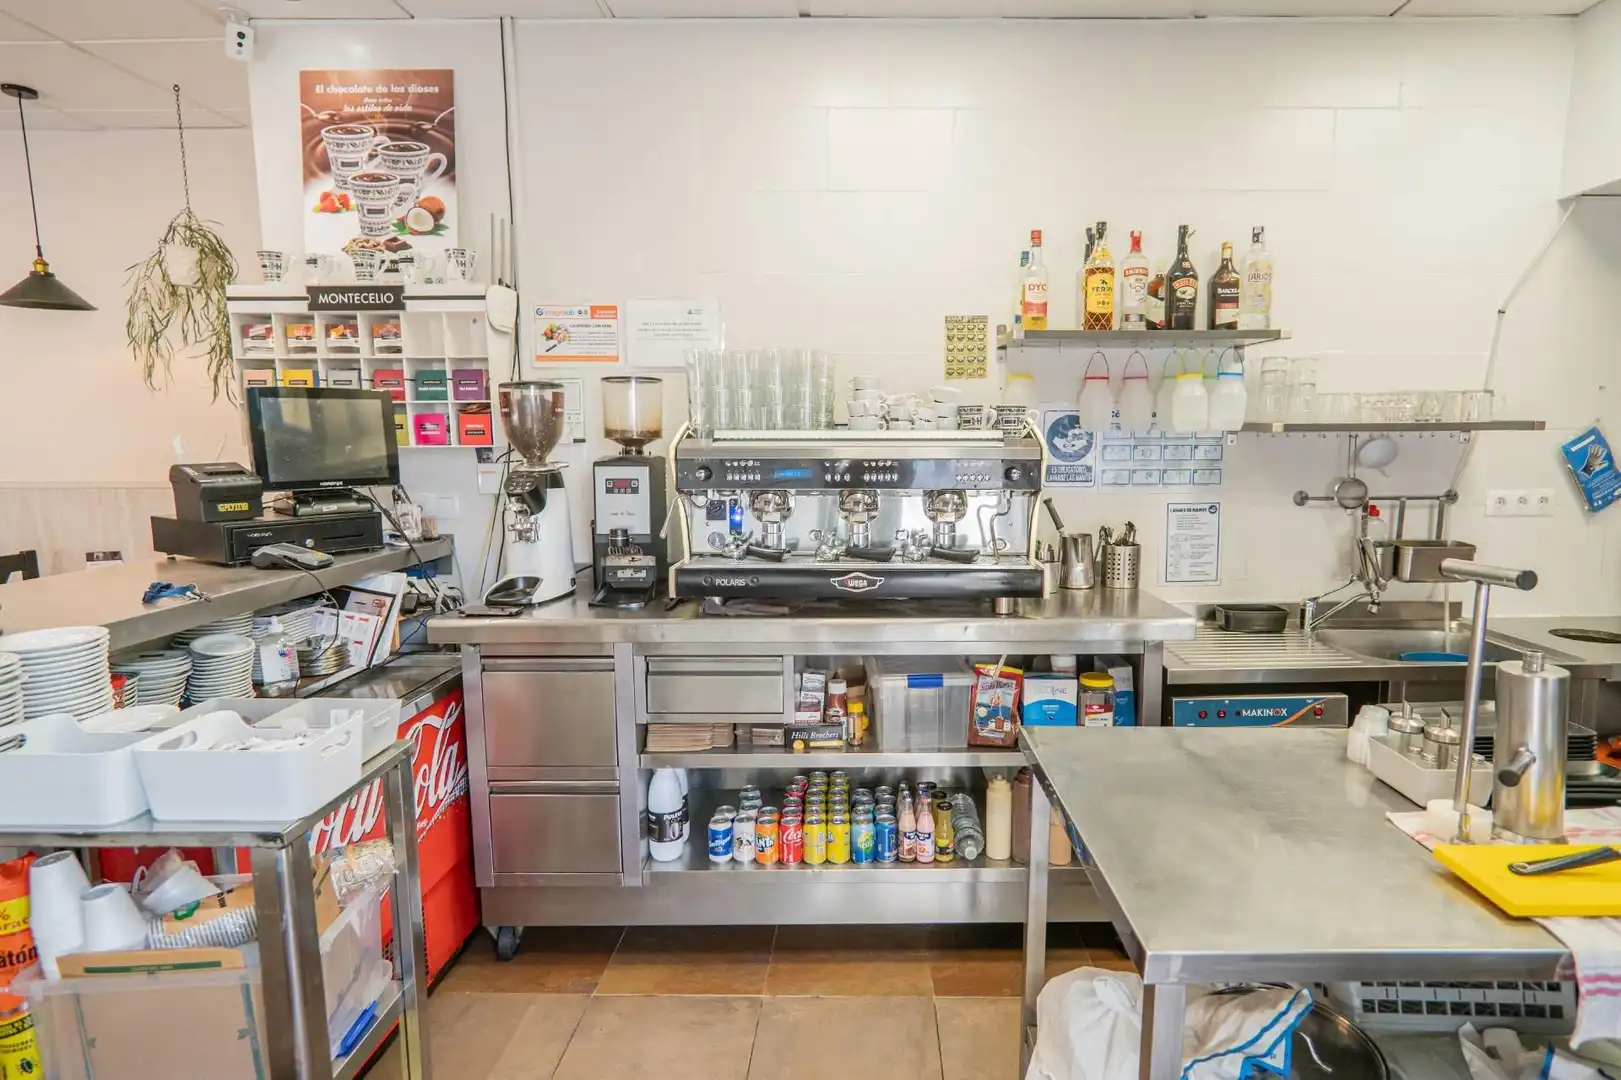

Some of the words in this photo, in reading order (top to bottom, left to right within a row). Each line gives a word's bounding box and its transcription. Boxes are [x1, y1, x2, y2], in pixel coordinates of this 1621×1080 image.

[315, 84, 324, 94] El
[326, 84, 374, 94] chocolate
[375, 84, 389, 94] de
[391, 84, 405, 94] los
[408, 84, 440, 94] dioses
[318, 292, 394, 304] MONTECELIO
[715, 578, 746, 586] POLARIS
[1242, 708, 1288, 717] MAKINOX
[791, 731, 808, 739] Hills
[810, 730, 839, 740] Brothers
[0, 943, 38, 969] atón
